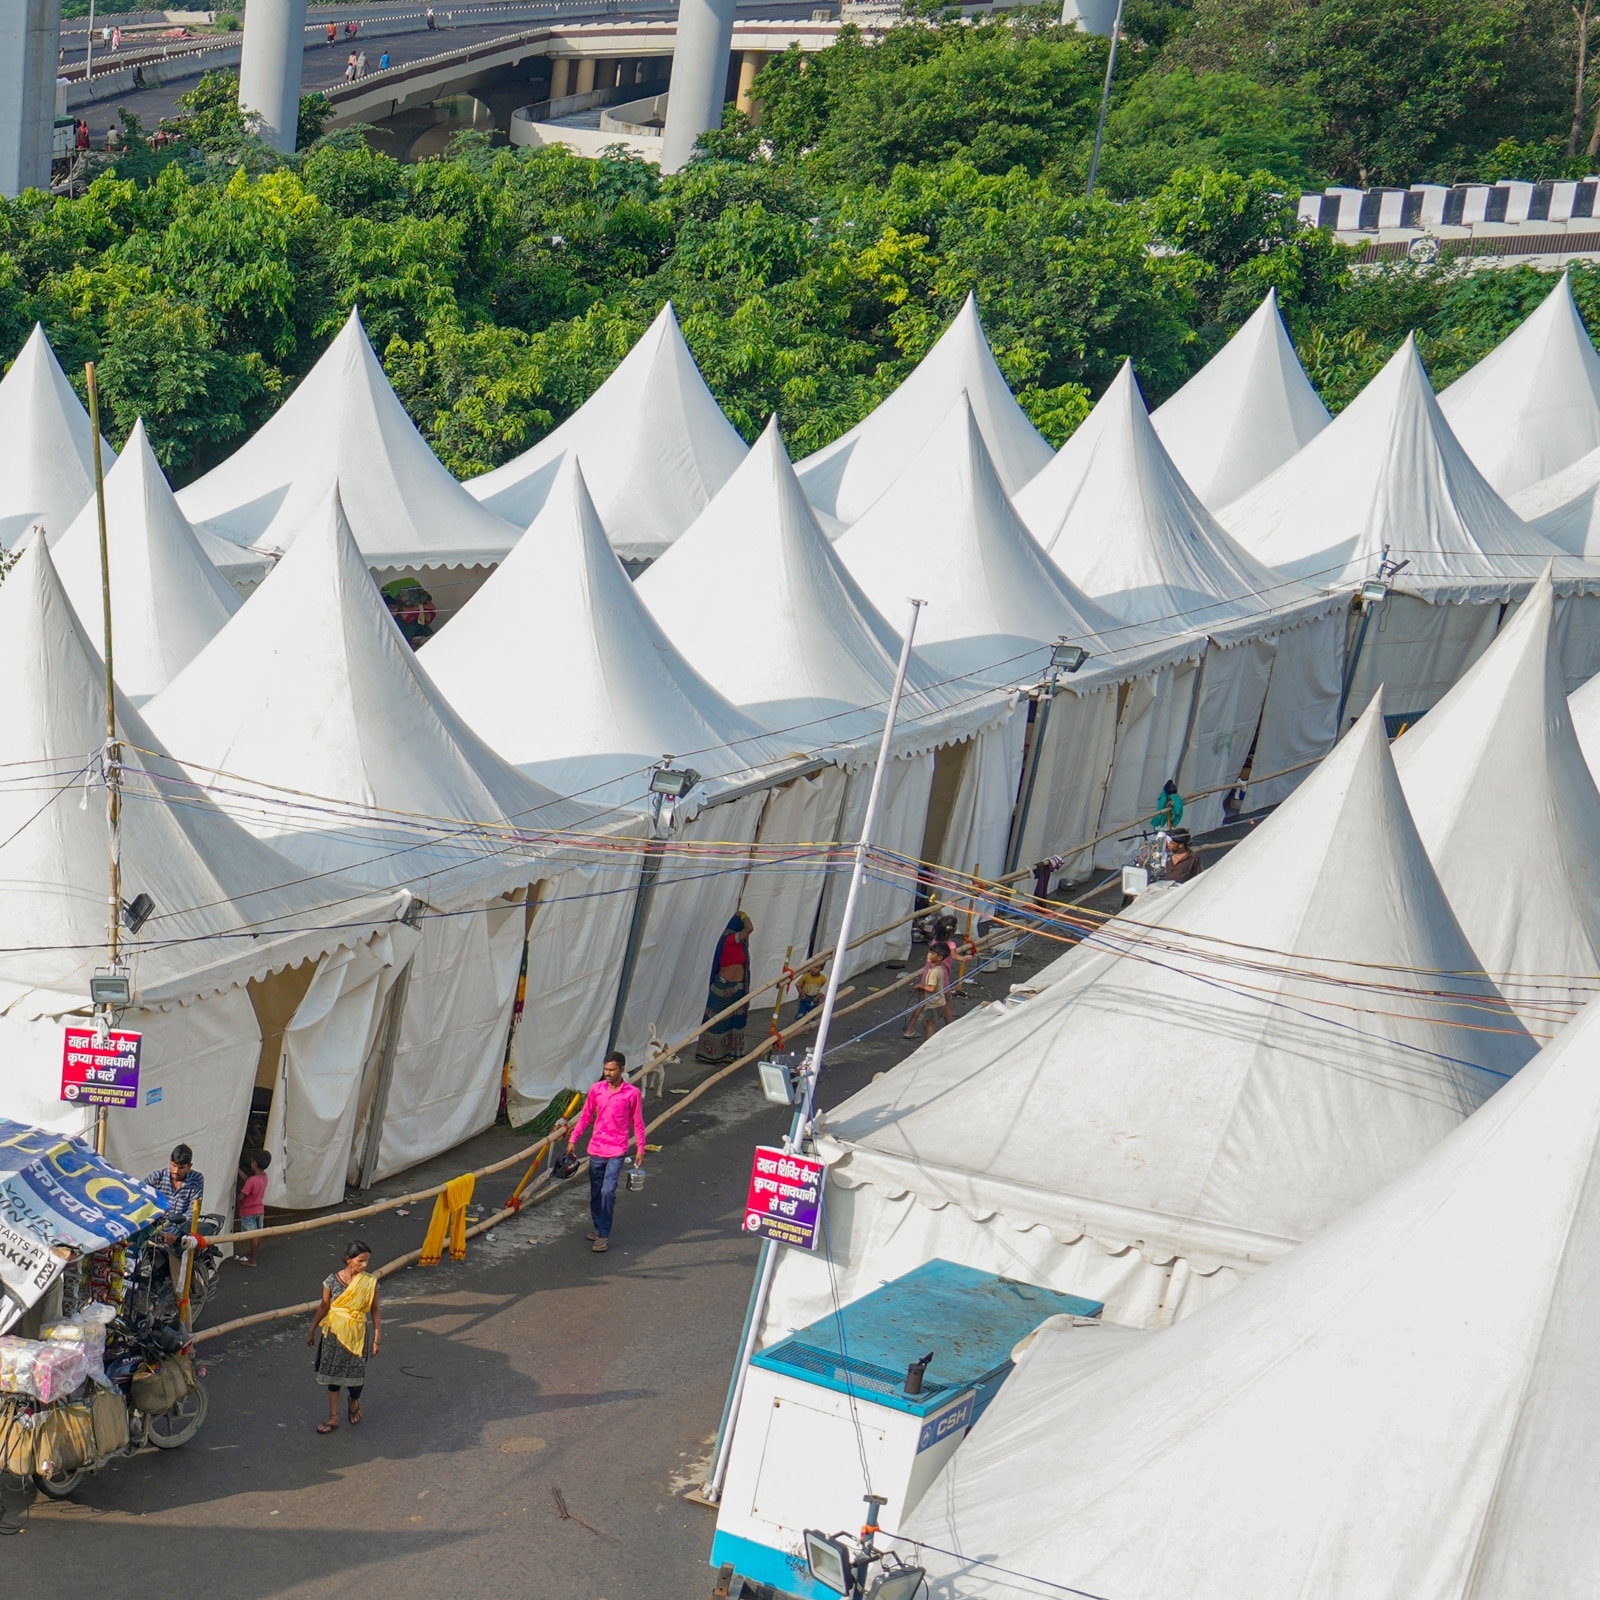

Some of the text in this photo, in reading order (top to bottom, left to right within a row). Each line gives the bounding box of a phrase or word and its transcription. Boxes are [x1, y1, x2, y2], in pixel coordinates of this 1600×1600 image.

[67, 1035, 90, 1049] राहत
[116, 1037, 138, 1053] कैम्प
[94, 1055, 136, 1068] सावधानी
[86, 1066, 117, 1082] से चलें
[756, 1157, 820, 1186] राहत शिविर कैम्प
[779, 1182, 816, 1204] सावधानी
[6, 1182, 54, 1230] YOUR
[769, 1196, 798, 1216] से चलें
[789, 1234, 803, 1244] DELHI
[30, 1247, 46, 1260] AT
